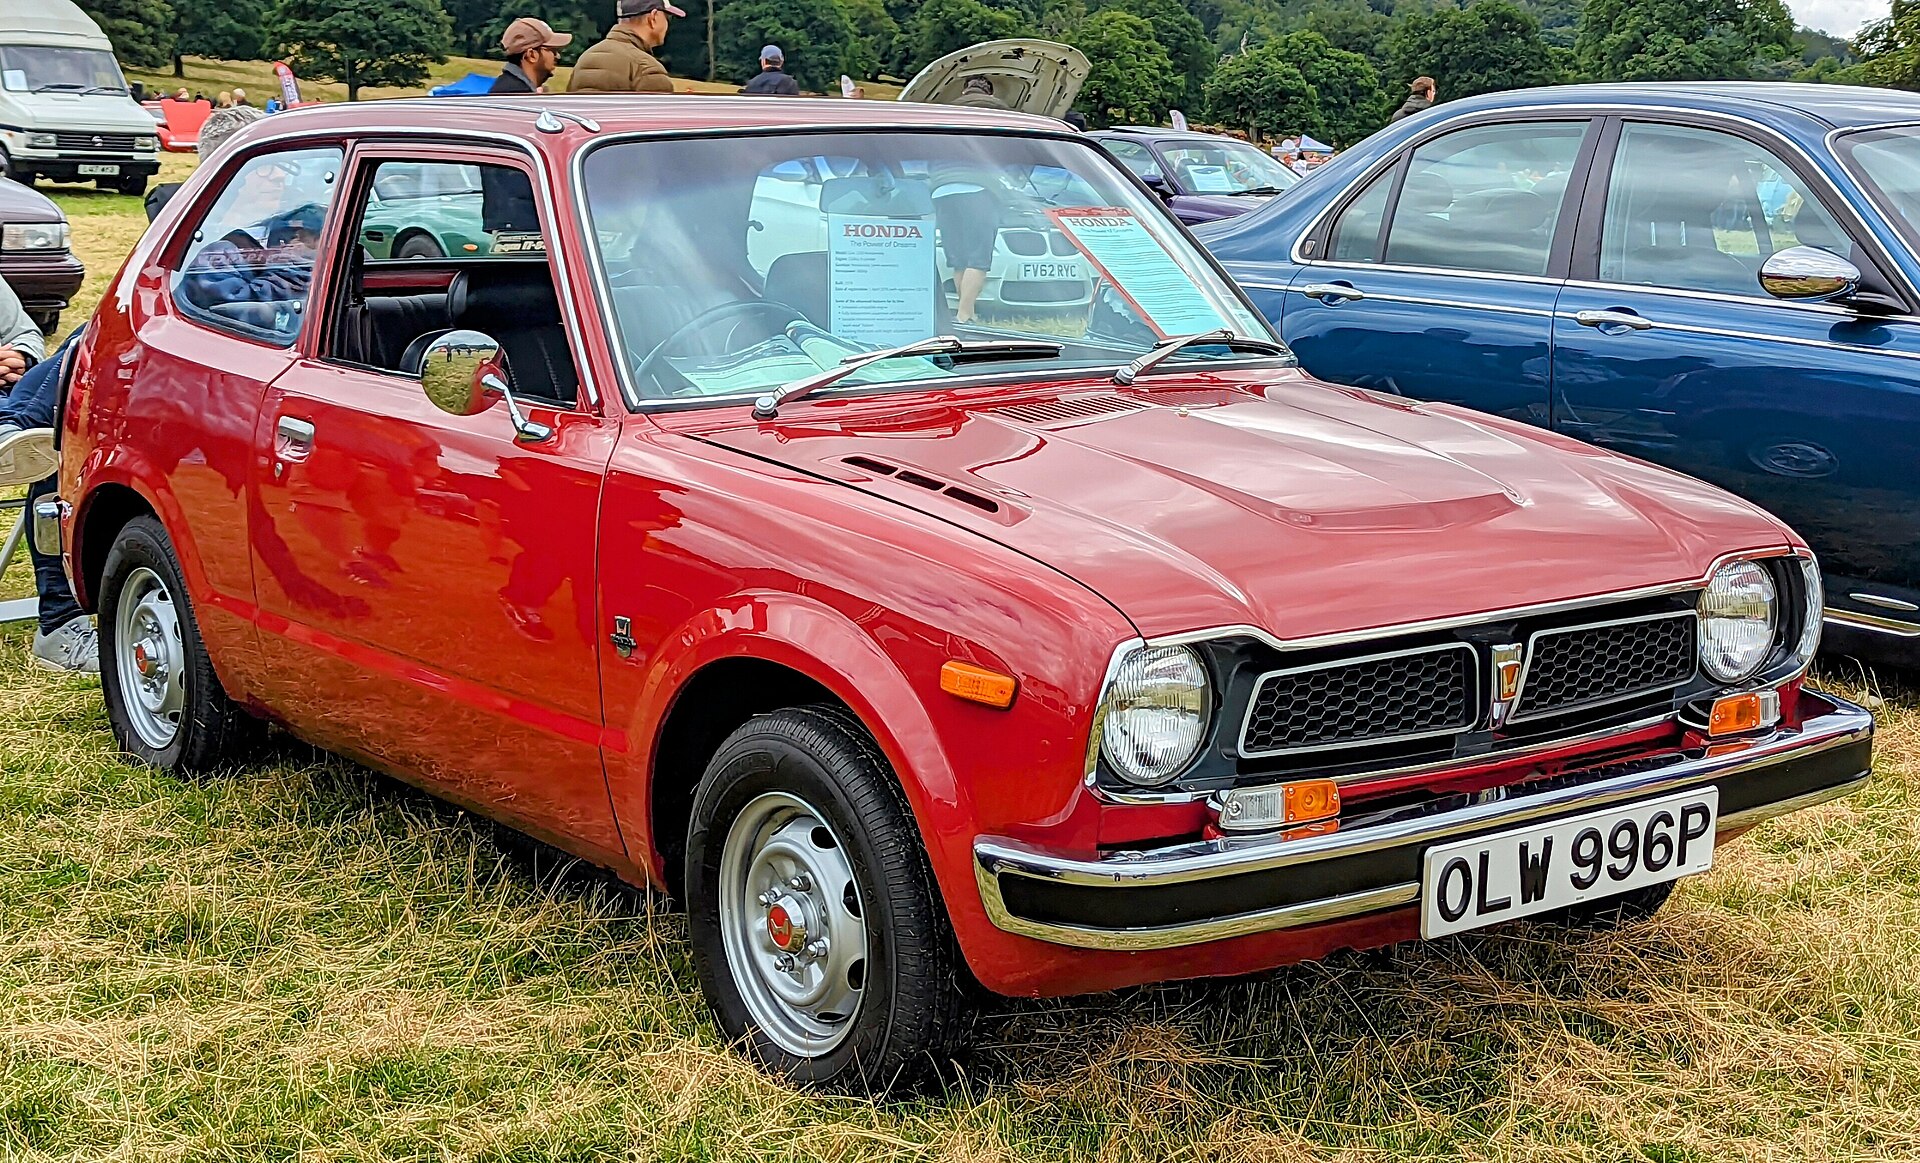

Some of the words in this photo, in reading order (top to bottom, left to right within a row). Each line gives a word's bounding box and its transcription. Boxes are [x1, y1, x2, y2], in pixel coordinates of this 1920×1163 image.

[1067, 218, 1133, 226] HONDA
[843, 224, 922, 238] HONDA
[1024, 264, 1055, 277] FV62
[1057, 265, 1076, 277] RYC
[1436, 835, 1553, 923] OLW
[1569, 801, 1711, 891] 996P
